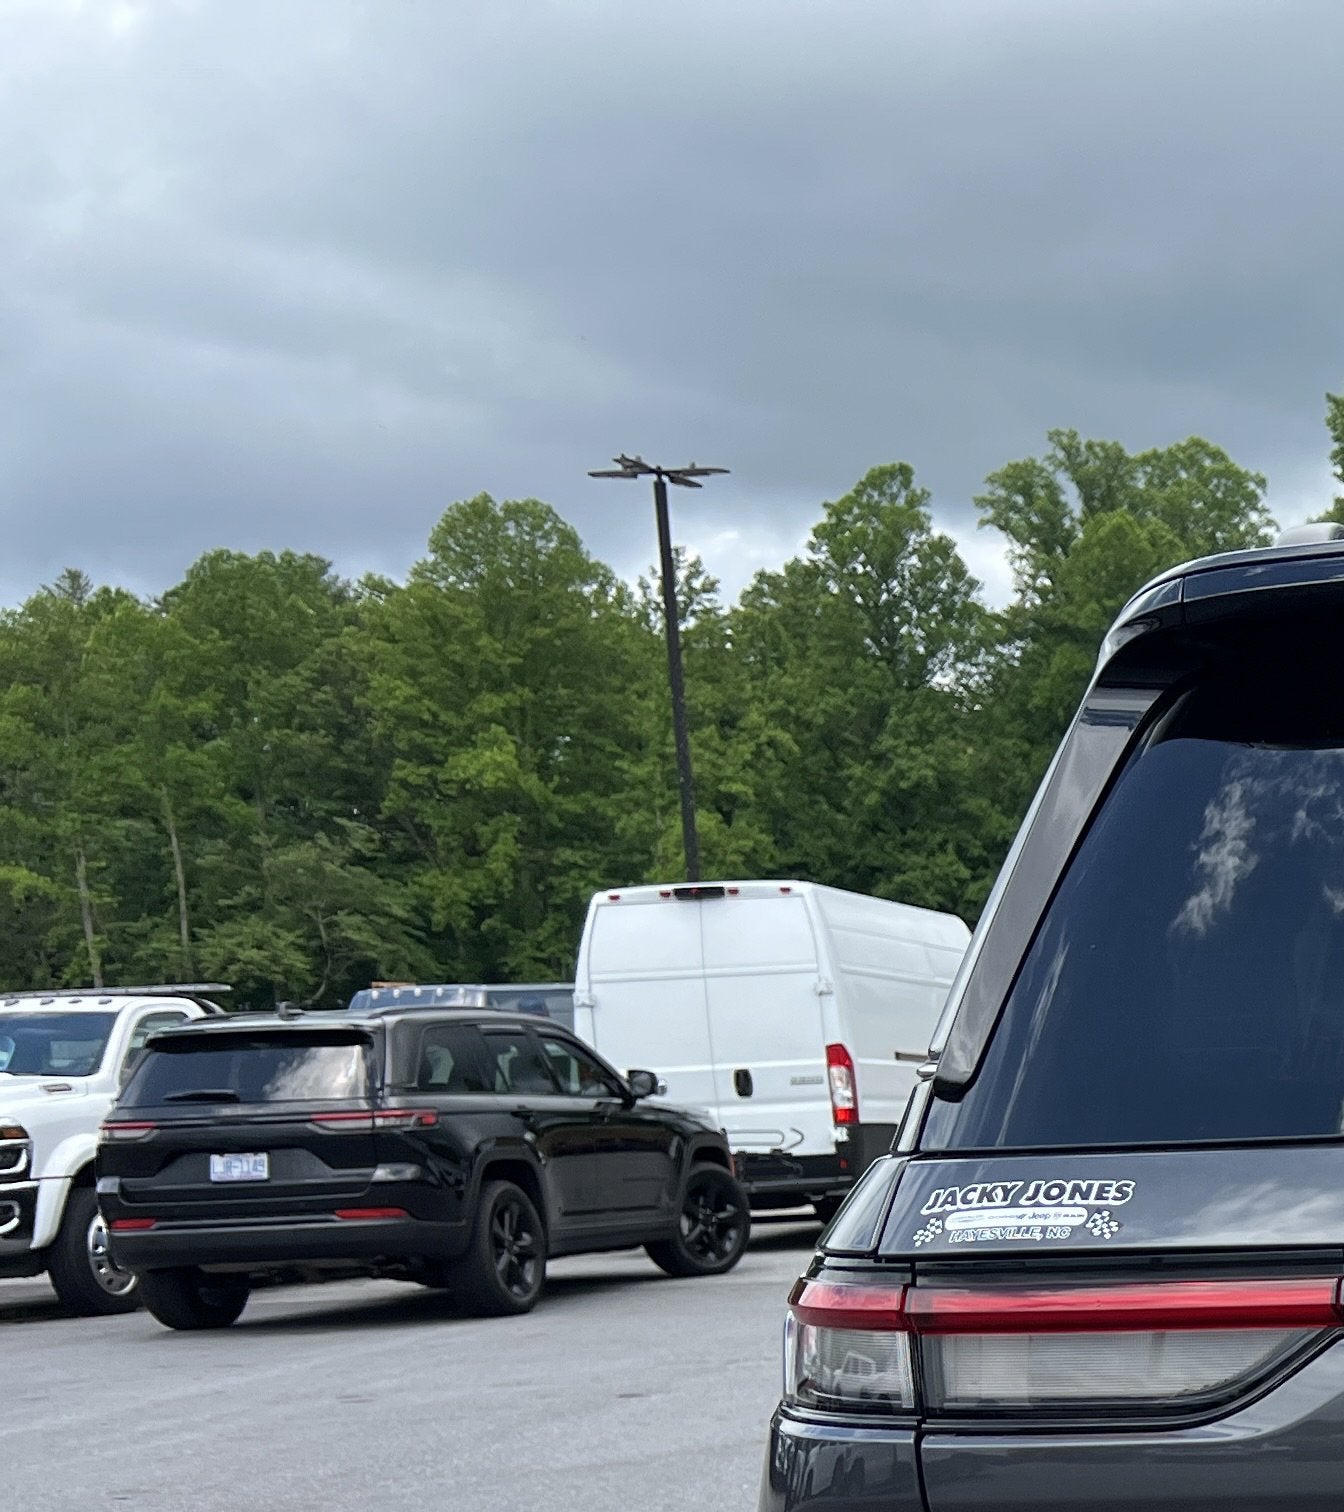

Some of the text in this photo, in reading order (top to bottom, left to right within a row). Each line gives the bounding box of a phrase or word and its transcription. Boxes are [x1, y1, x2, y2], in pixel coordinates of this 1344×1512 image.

[920, 1179, 1136, 1215] JACKY JONES
[949, 1226, 1071, 1243] HAYESVILLE, NC
